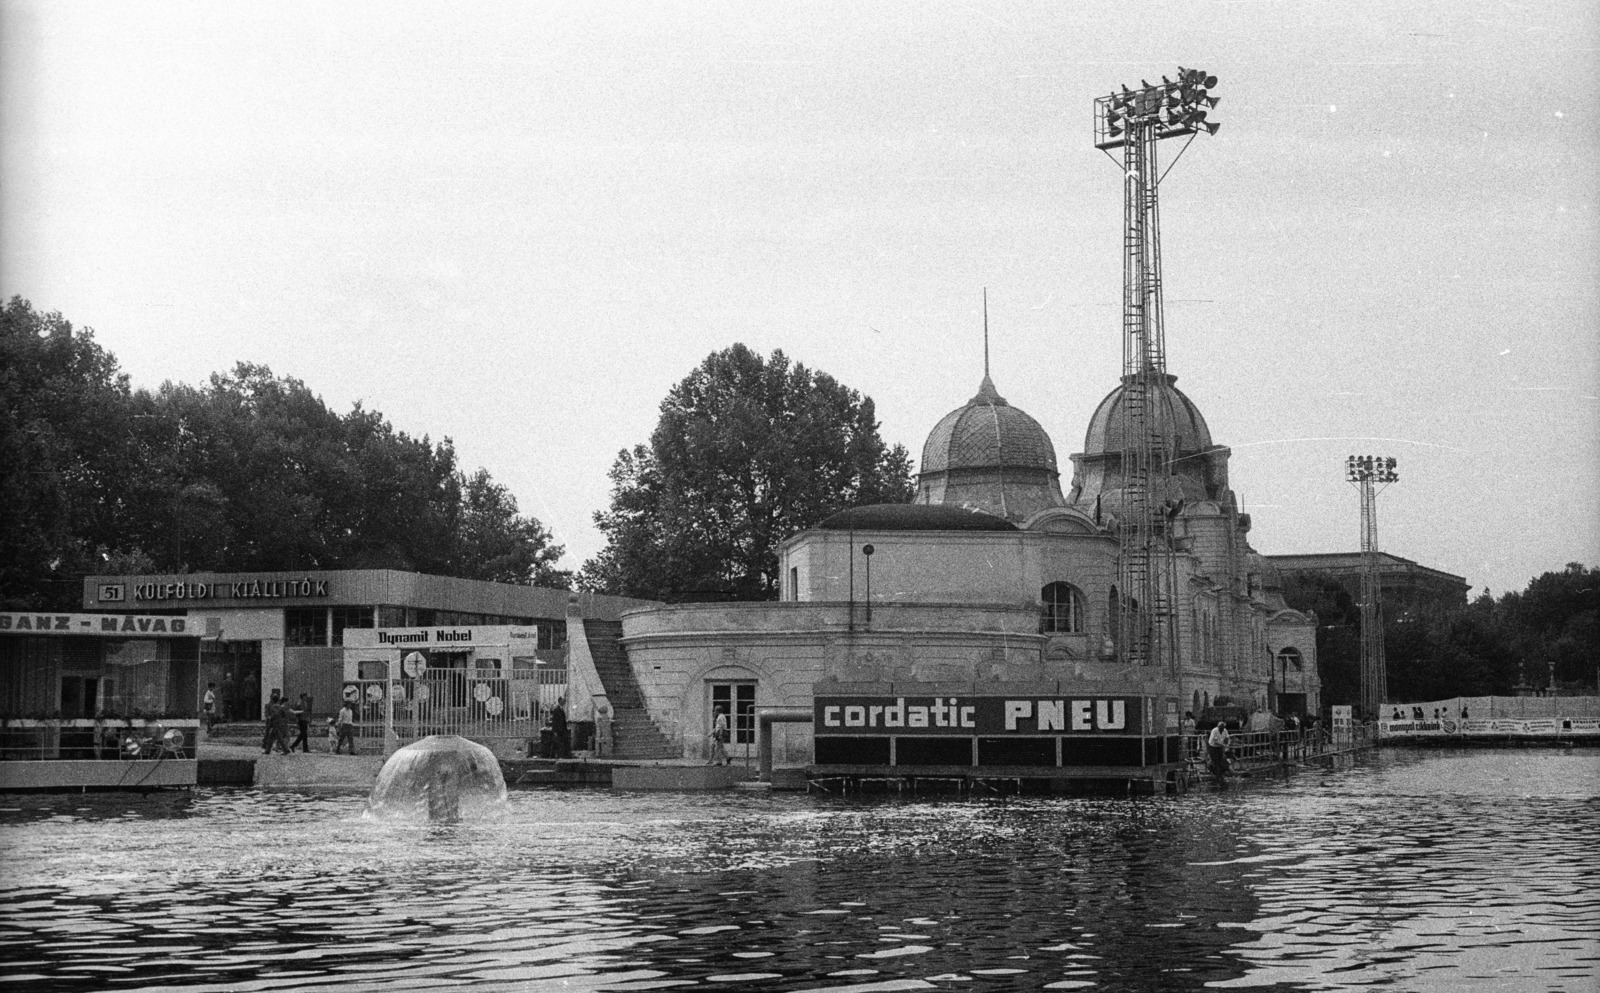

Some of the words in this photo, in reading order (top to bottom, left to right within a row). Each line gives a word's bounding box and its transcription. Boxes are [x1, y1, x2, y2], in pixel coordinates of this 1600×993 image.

[104, 586, 120, 599] 51
[0, 615, 70, 631] GANZ
[378, 630, 429, 645] Dynamit
[436, 630, 472, 642] Nobel
[823, 697, 976, 728] cordatic
[1004, 699, 1126, 731] PNEU
